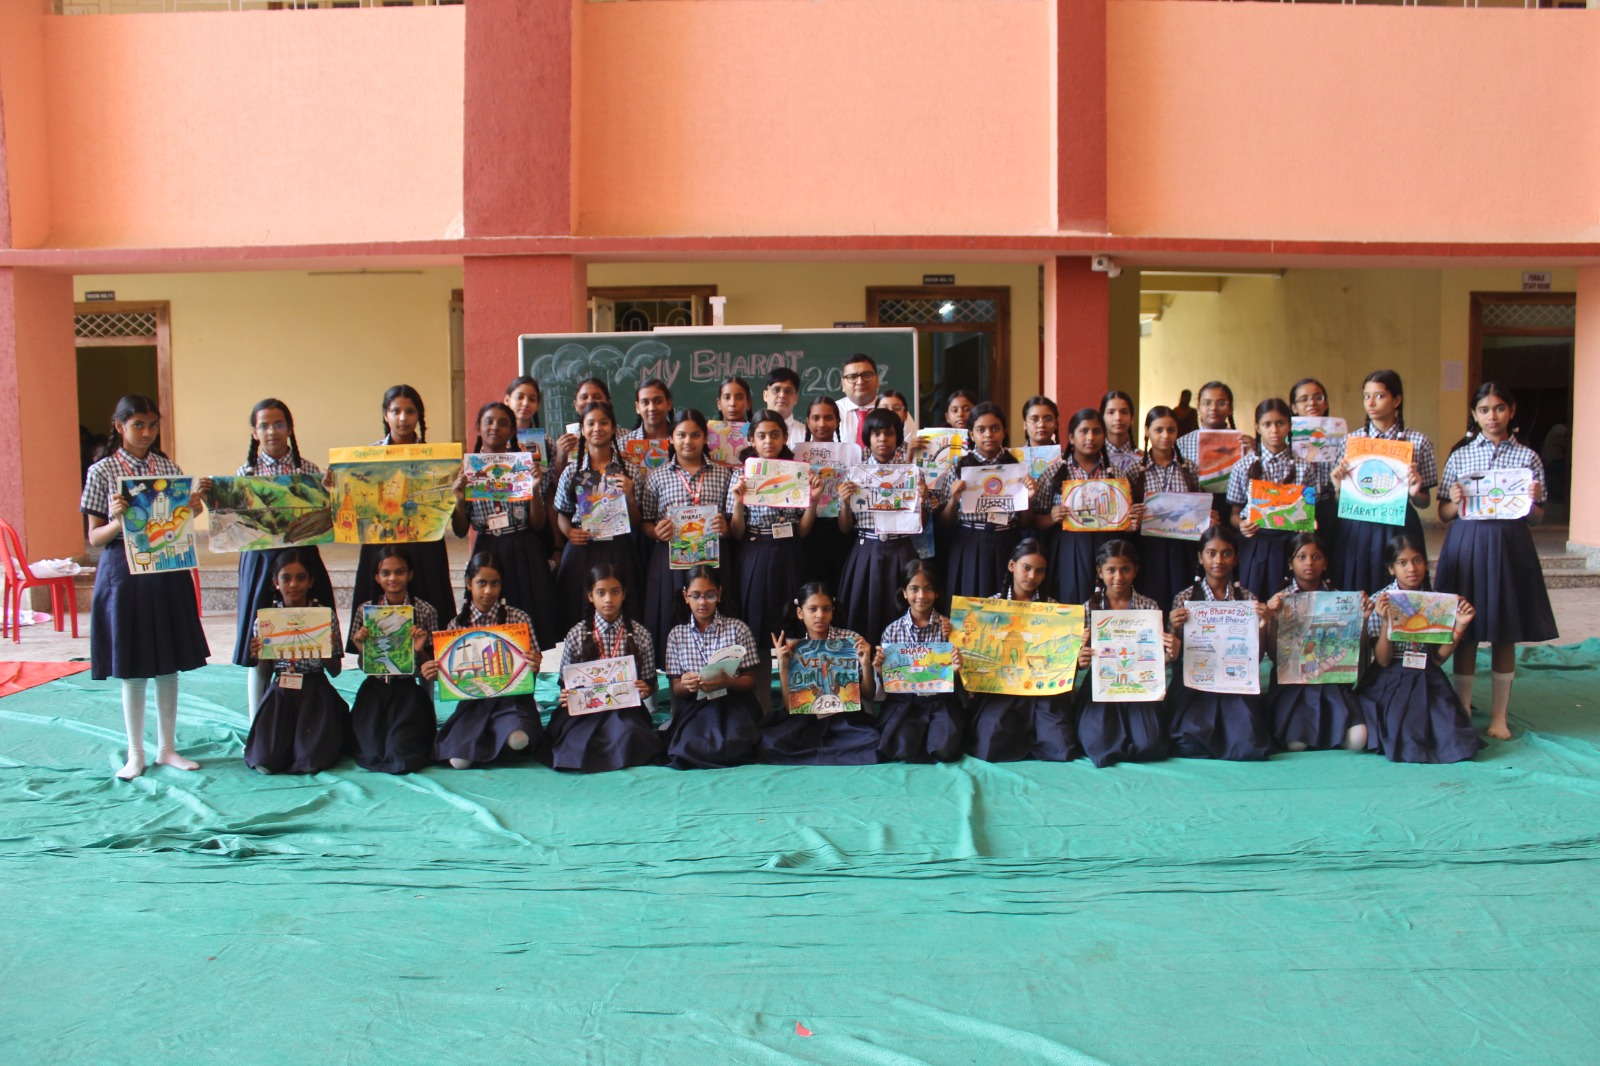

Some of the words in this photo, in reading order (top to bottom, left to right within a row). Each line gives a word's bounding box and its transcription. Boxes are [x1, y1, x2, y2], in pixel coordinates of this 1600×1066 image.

[690, 349, 804, 382] BHARAT
[801, 364, 889, 395] 207
[900, 647, 933, 655] BHARAT
